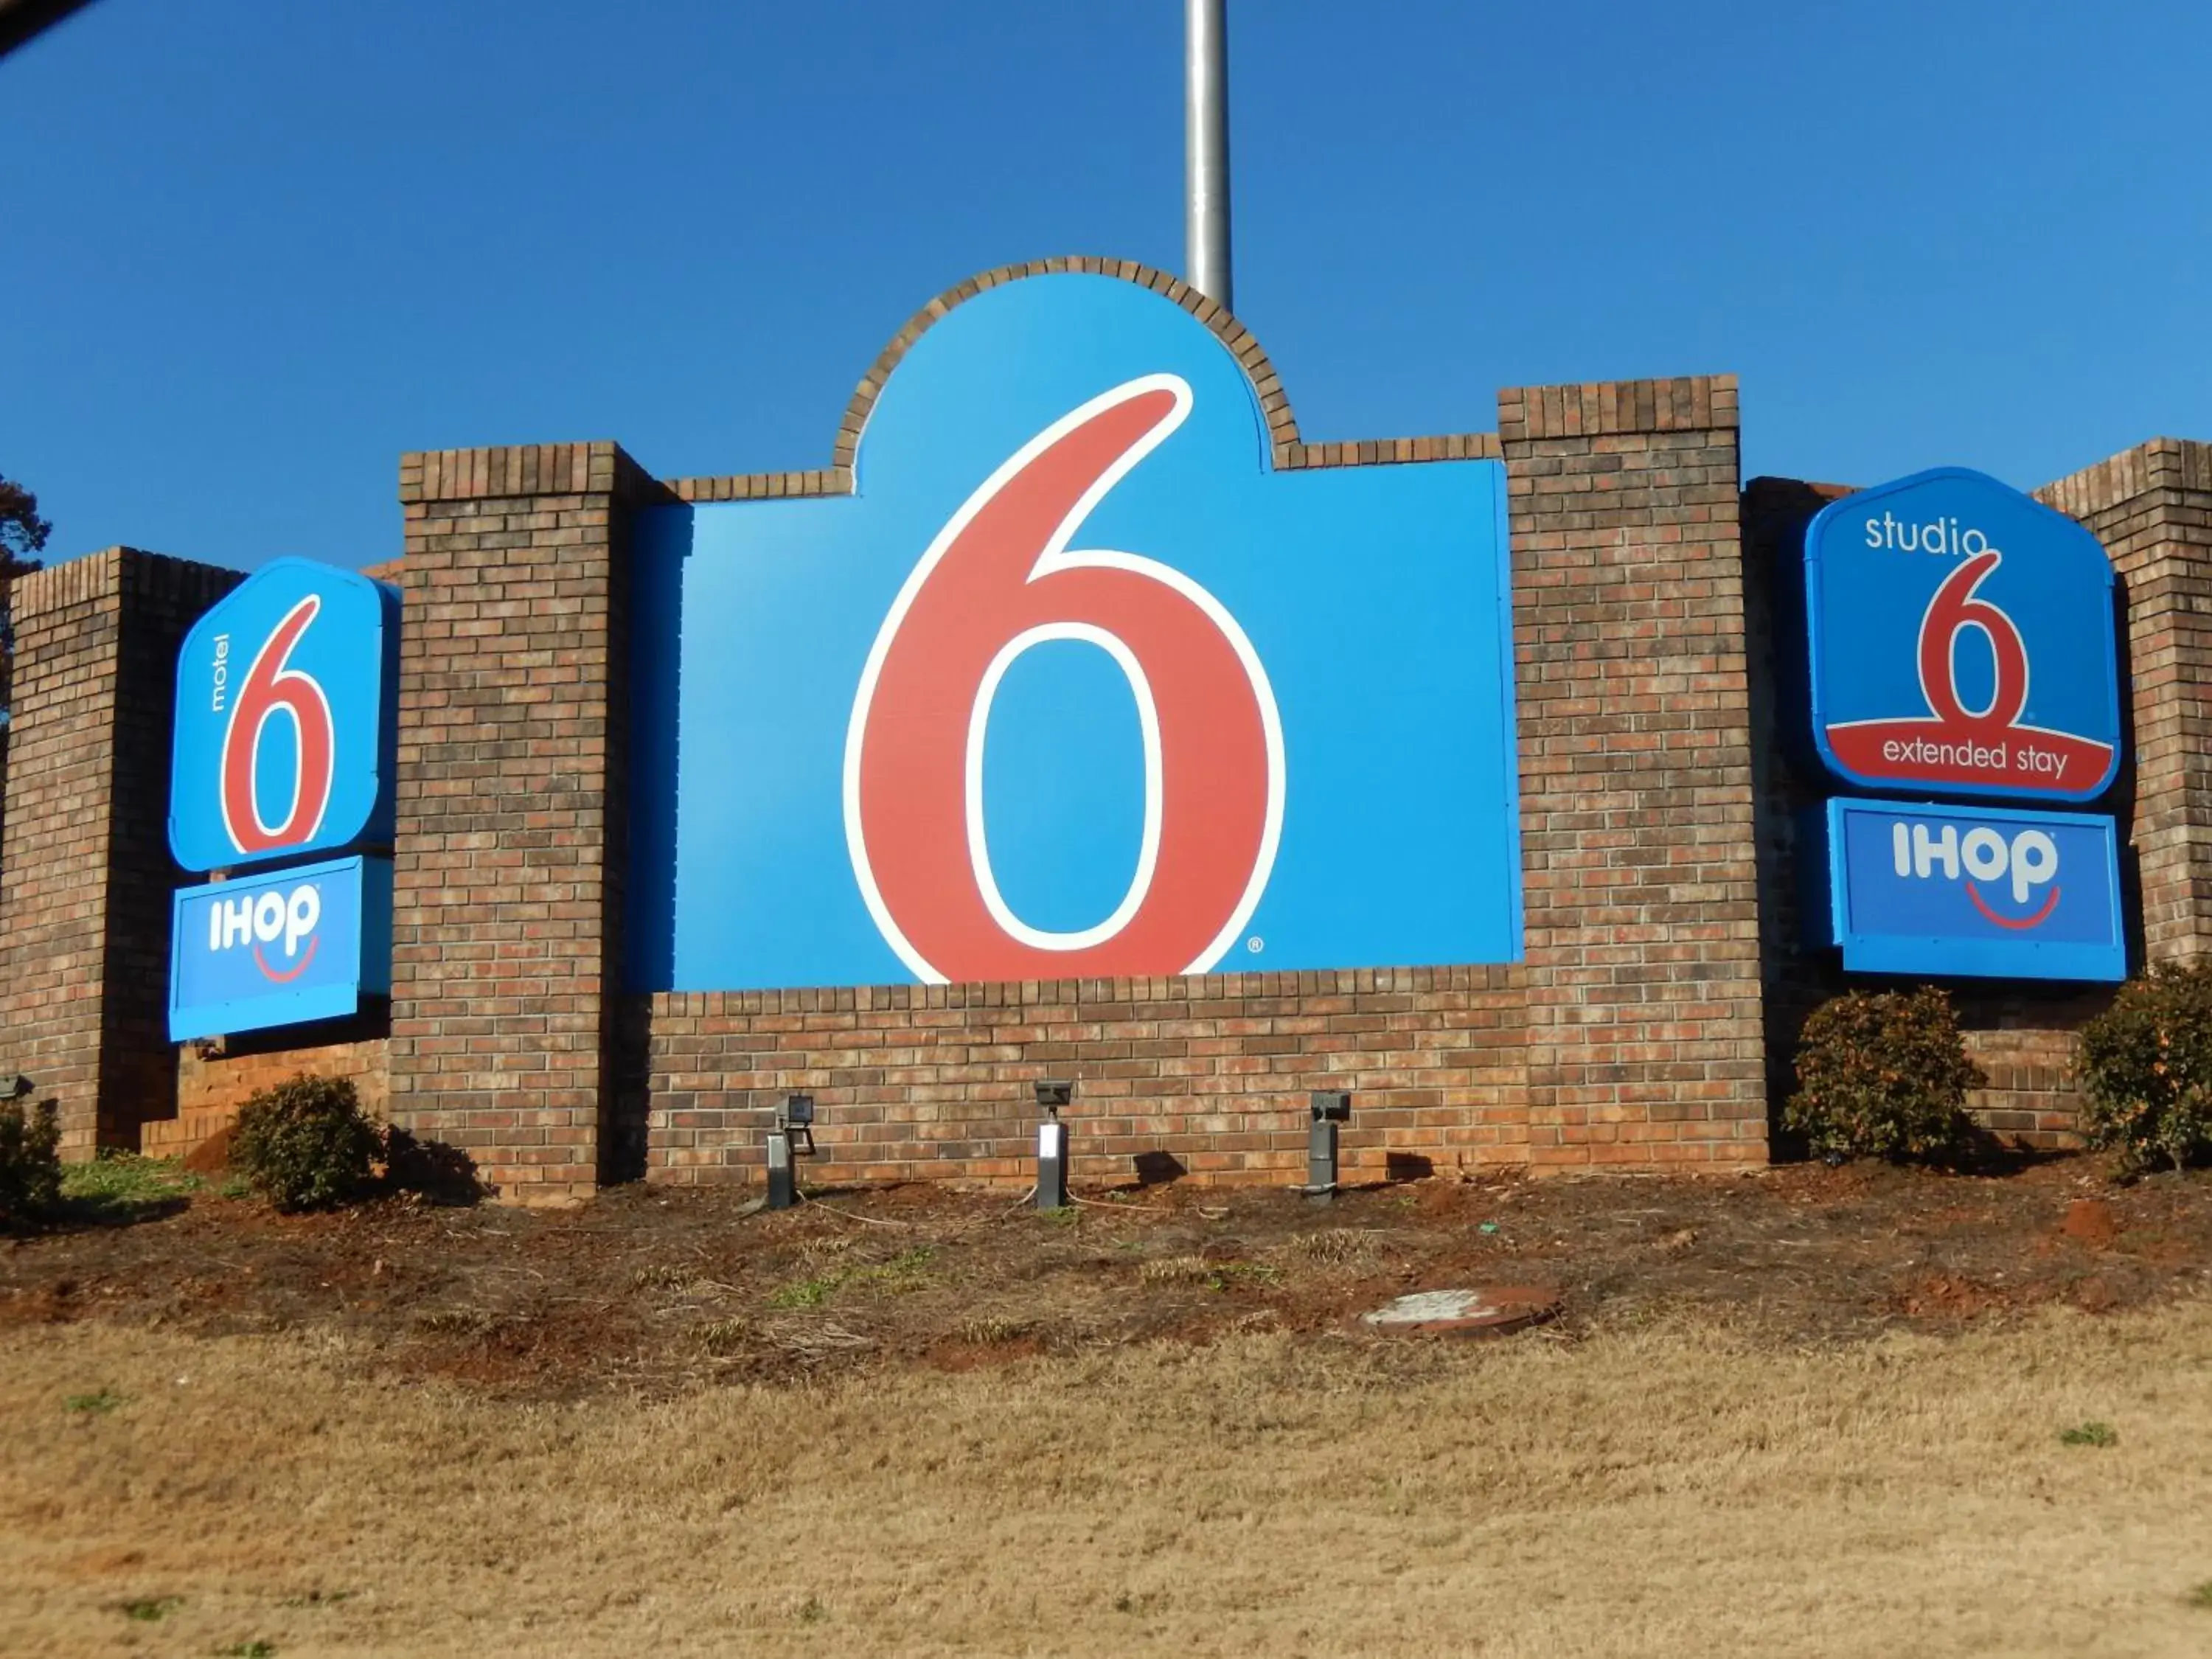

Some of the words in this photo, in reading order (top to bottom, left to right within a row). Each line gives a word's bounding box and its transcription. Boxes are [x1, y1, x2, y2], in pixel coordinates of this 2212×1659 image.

[1865, 510, 1988, 558] studio
[212, 633, 229, 712] motel
[843, 372, 1286, 985] 6
[1917, 549, 2029, 726] 6
[220, 594, 335, 855] 6
[1883, 738, 2006, 770] extended
[2017, 745, 2067, 779] stay
